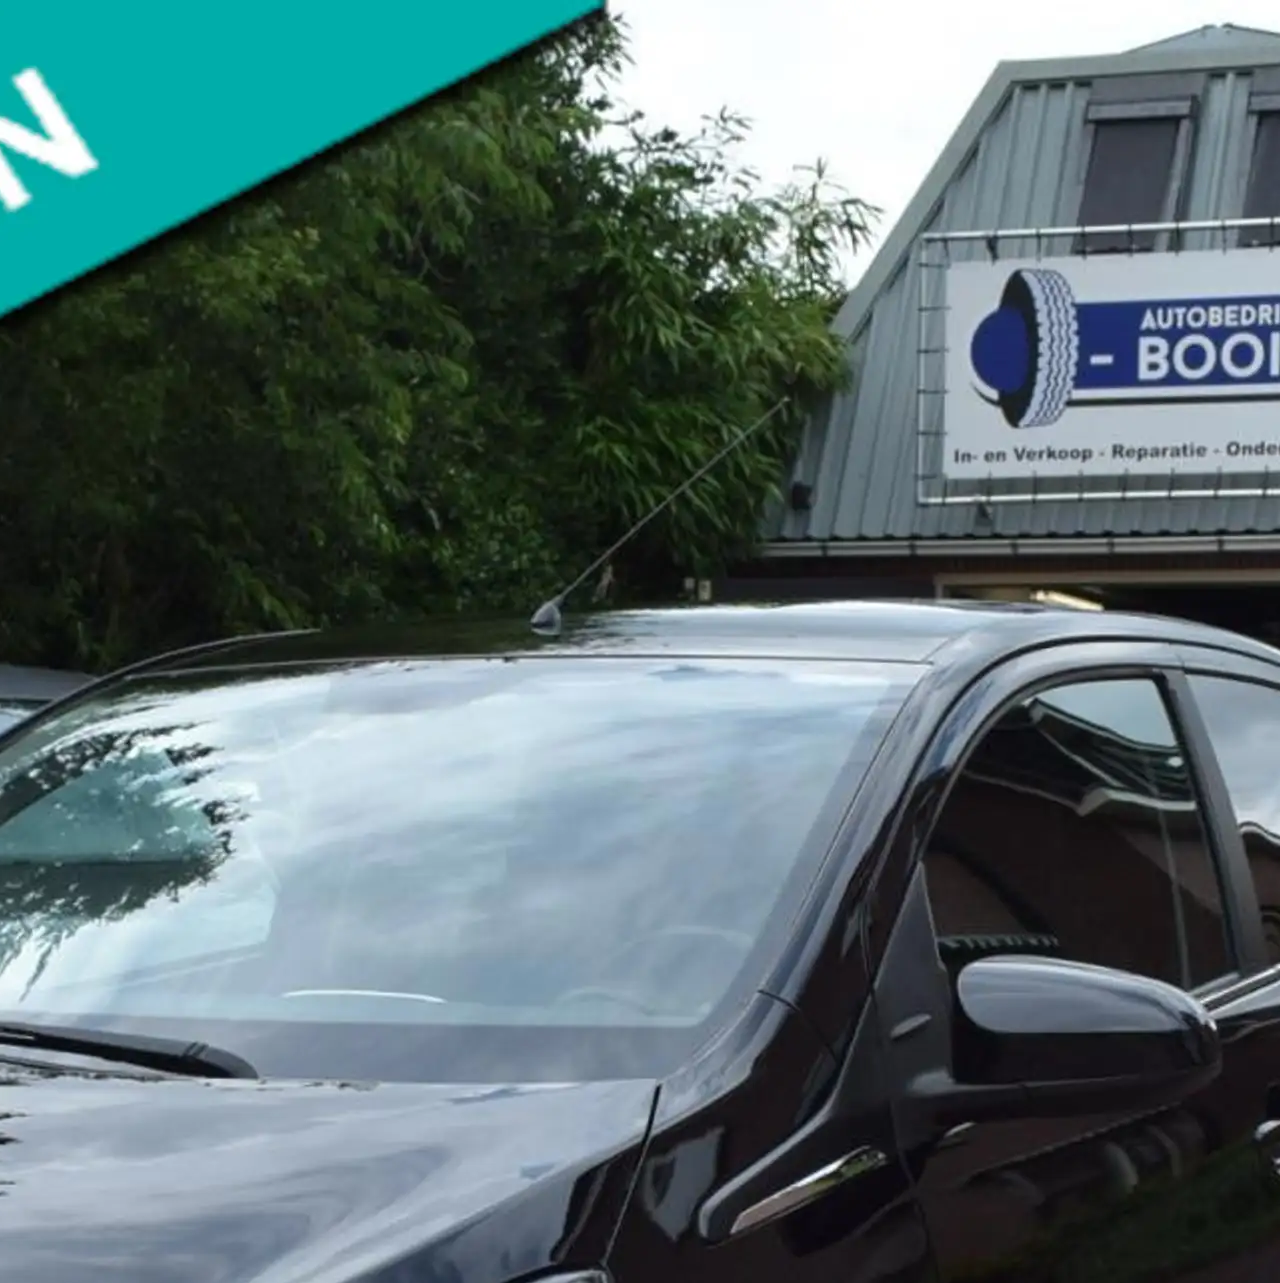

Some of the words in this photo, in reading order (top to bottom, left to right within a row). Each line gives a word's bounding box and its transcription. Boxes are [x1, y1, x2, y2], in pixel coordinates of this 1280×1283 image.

[954, 449, 978, 463] In-
[984, 451, 1007, 462] en
[1014, 446, 1093, 463] Verkoop
[1112, 444, 1207, 460] Reparatie
